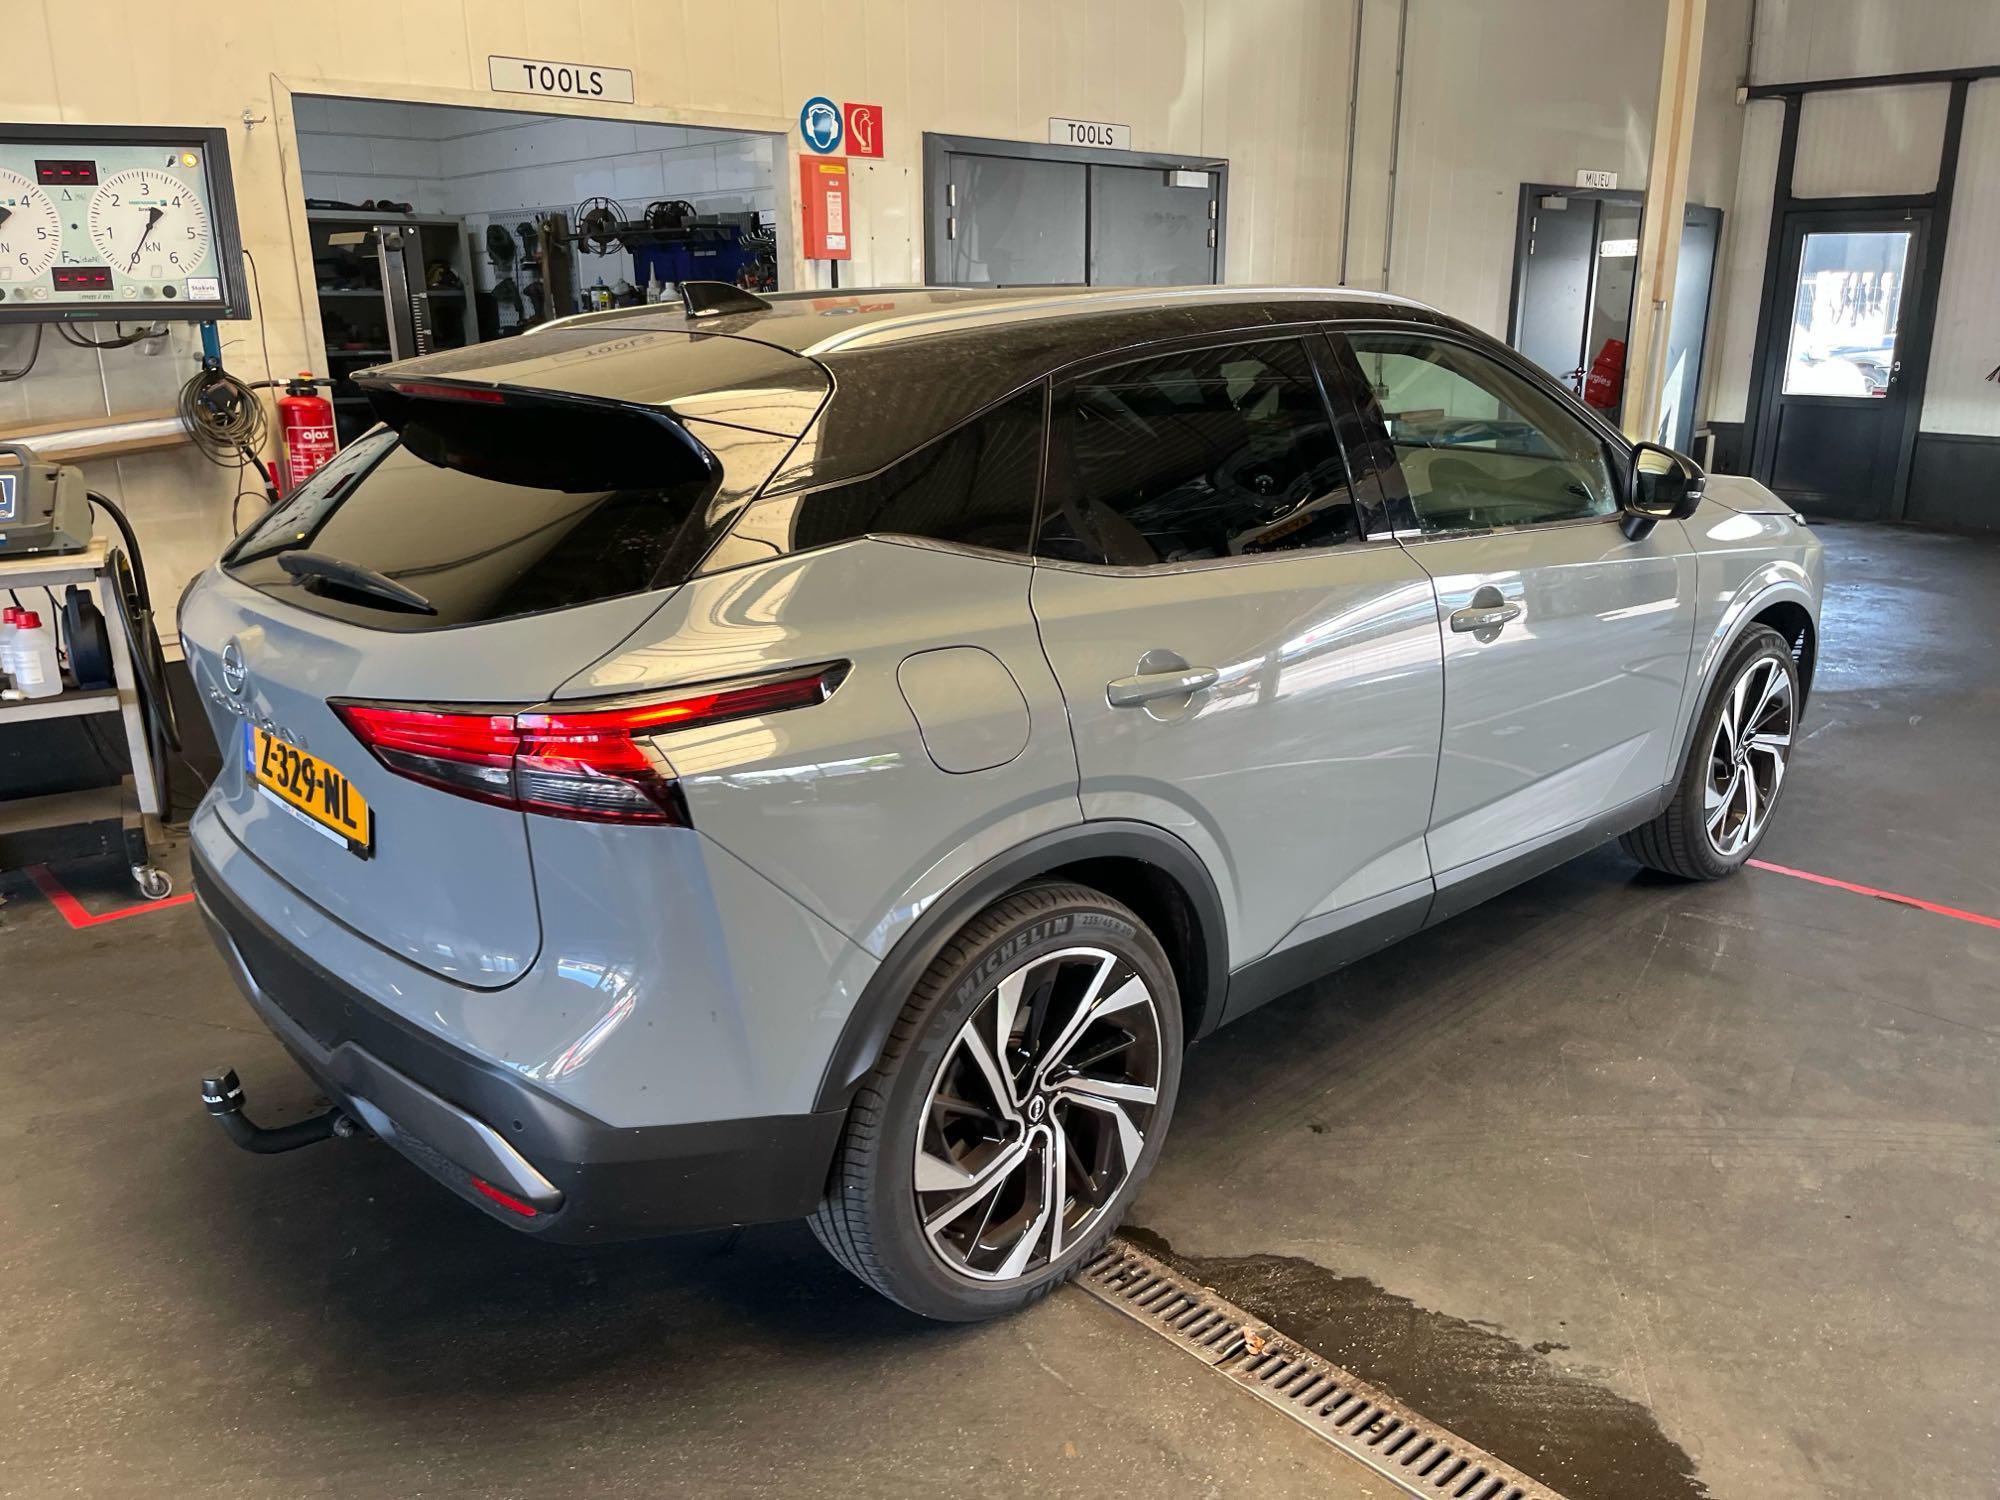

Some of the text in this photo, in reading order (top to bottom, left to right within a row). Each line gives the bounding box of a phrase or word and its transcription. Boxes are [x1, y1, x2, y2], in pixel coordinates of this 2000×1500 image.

[523, 64, 603, 96] TOOLS
[1068, 123, 1113, 146] TOOLS
[1585, 173, 1610, 188] MILIEU
[140, 183, 150, 196] 3
[20, 194, 31, 208] 4
[110, 193, 121, 207] 2
[171, 195, 182, 209] 4
[36, 227, 47, 240] 5
[106, 226, 113, 240] 1
[186, 226, 196, 240] 5
[145, 241, 161, 252] kN
[19, 252, 29, 266] 6
[131, 251, 141, 264] 0
[169, 251, 179, 264] 6
[303, 429, 329, 443] ajax
[260, 731, 357, 830] Z-329-NL
[956, 915, 1069, 1003] MICHELIN
